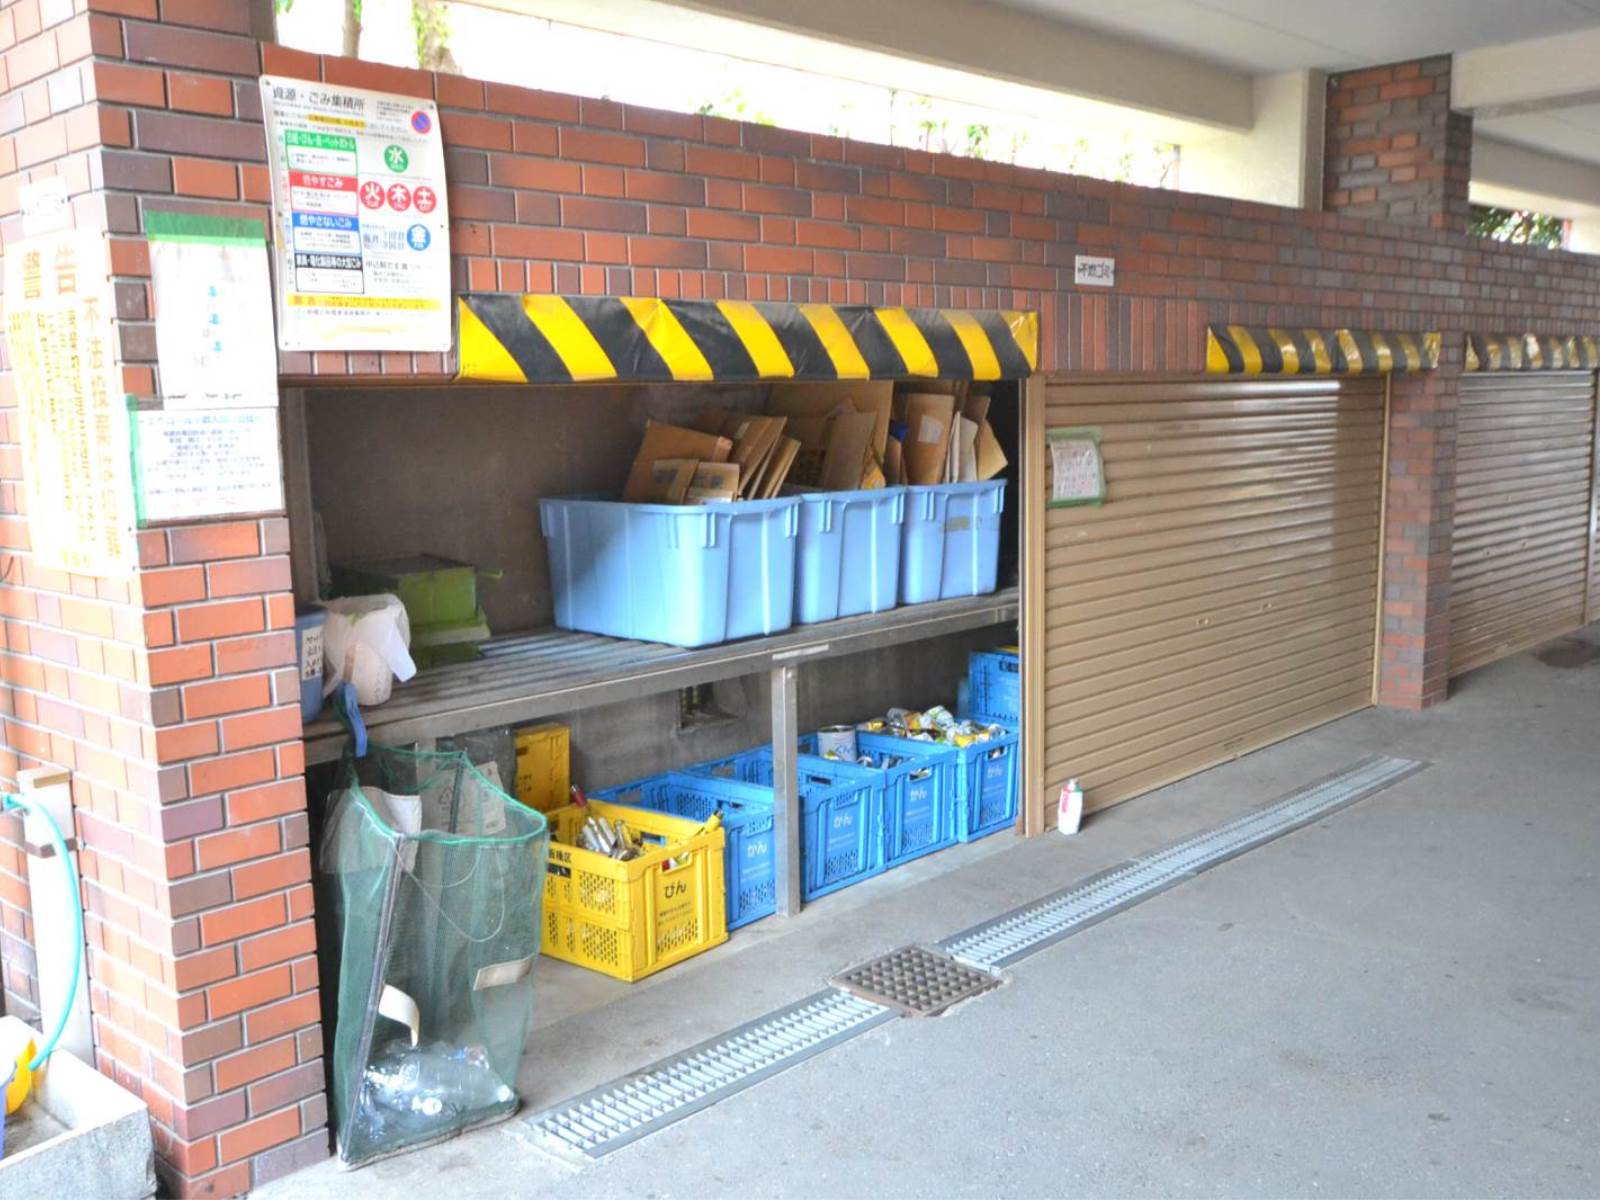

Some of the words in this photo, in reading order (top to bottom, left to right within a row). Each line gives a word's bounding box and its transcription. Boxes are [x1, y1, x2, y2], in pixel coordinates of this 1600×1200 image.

[388, 146, 404, 164] 水
[364, 184, 381, 201] 火
[390, 186, 408, 203] 木
[416, 189, 434, 205] 土
[663, 878, 688, 899] びん
